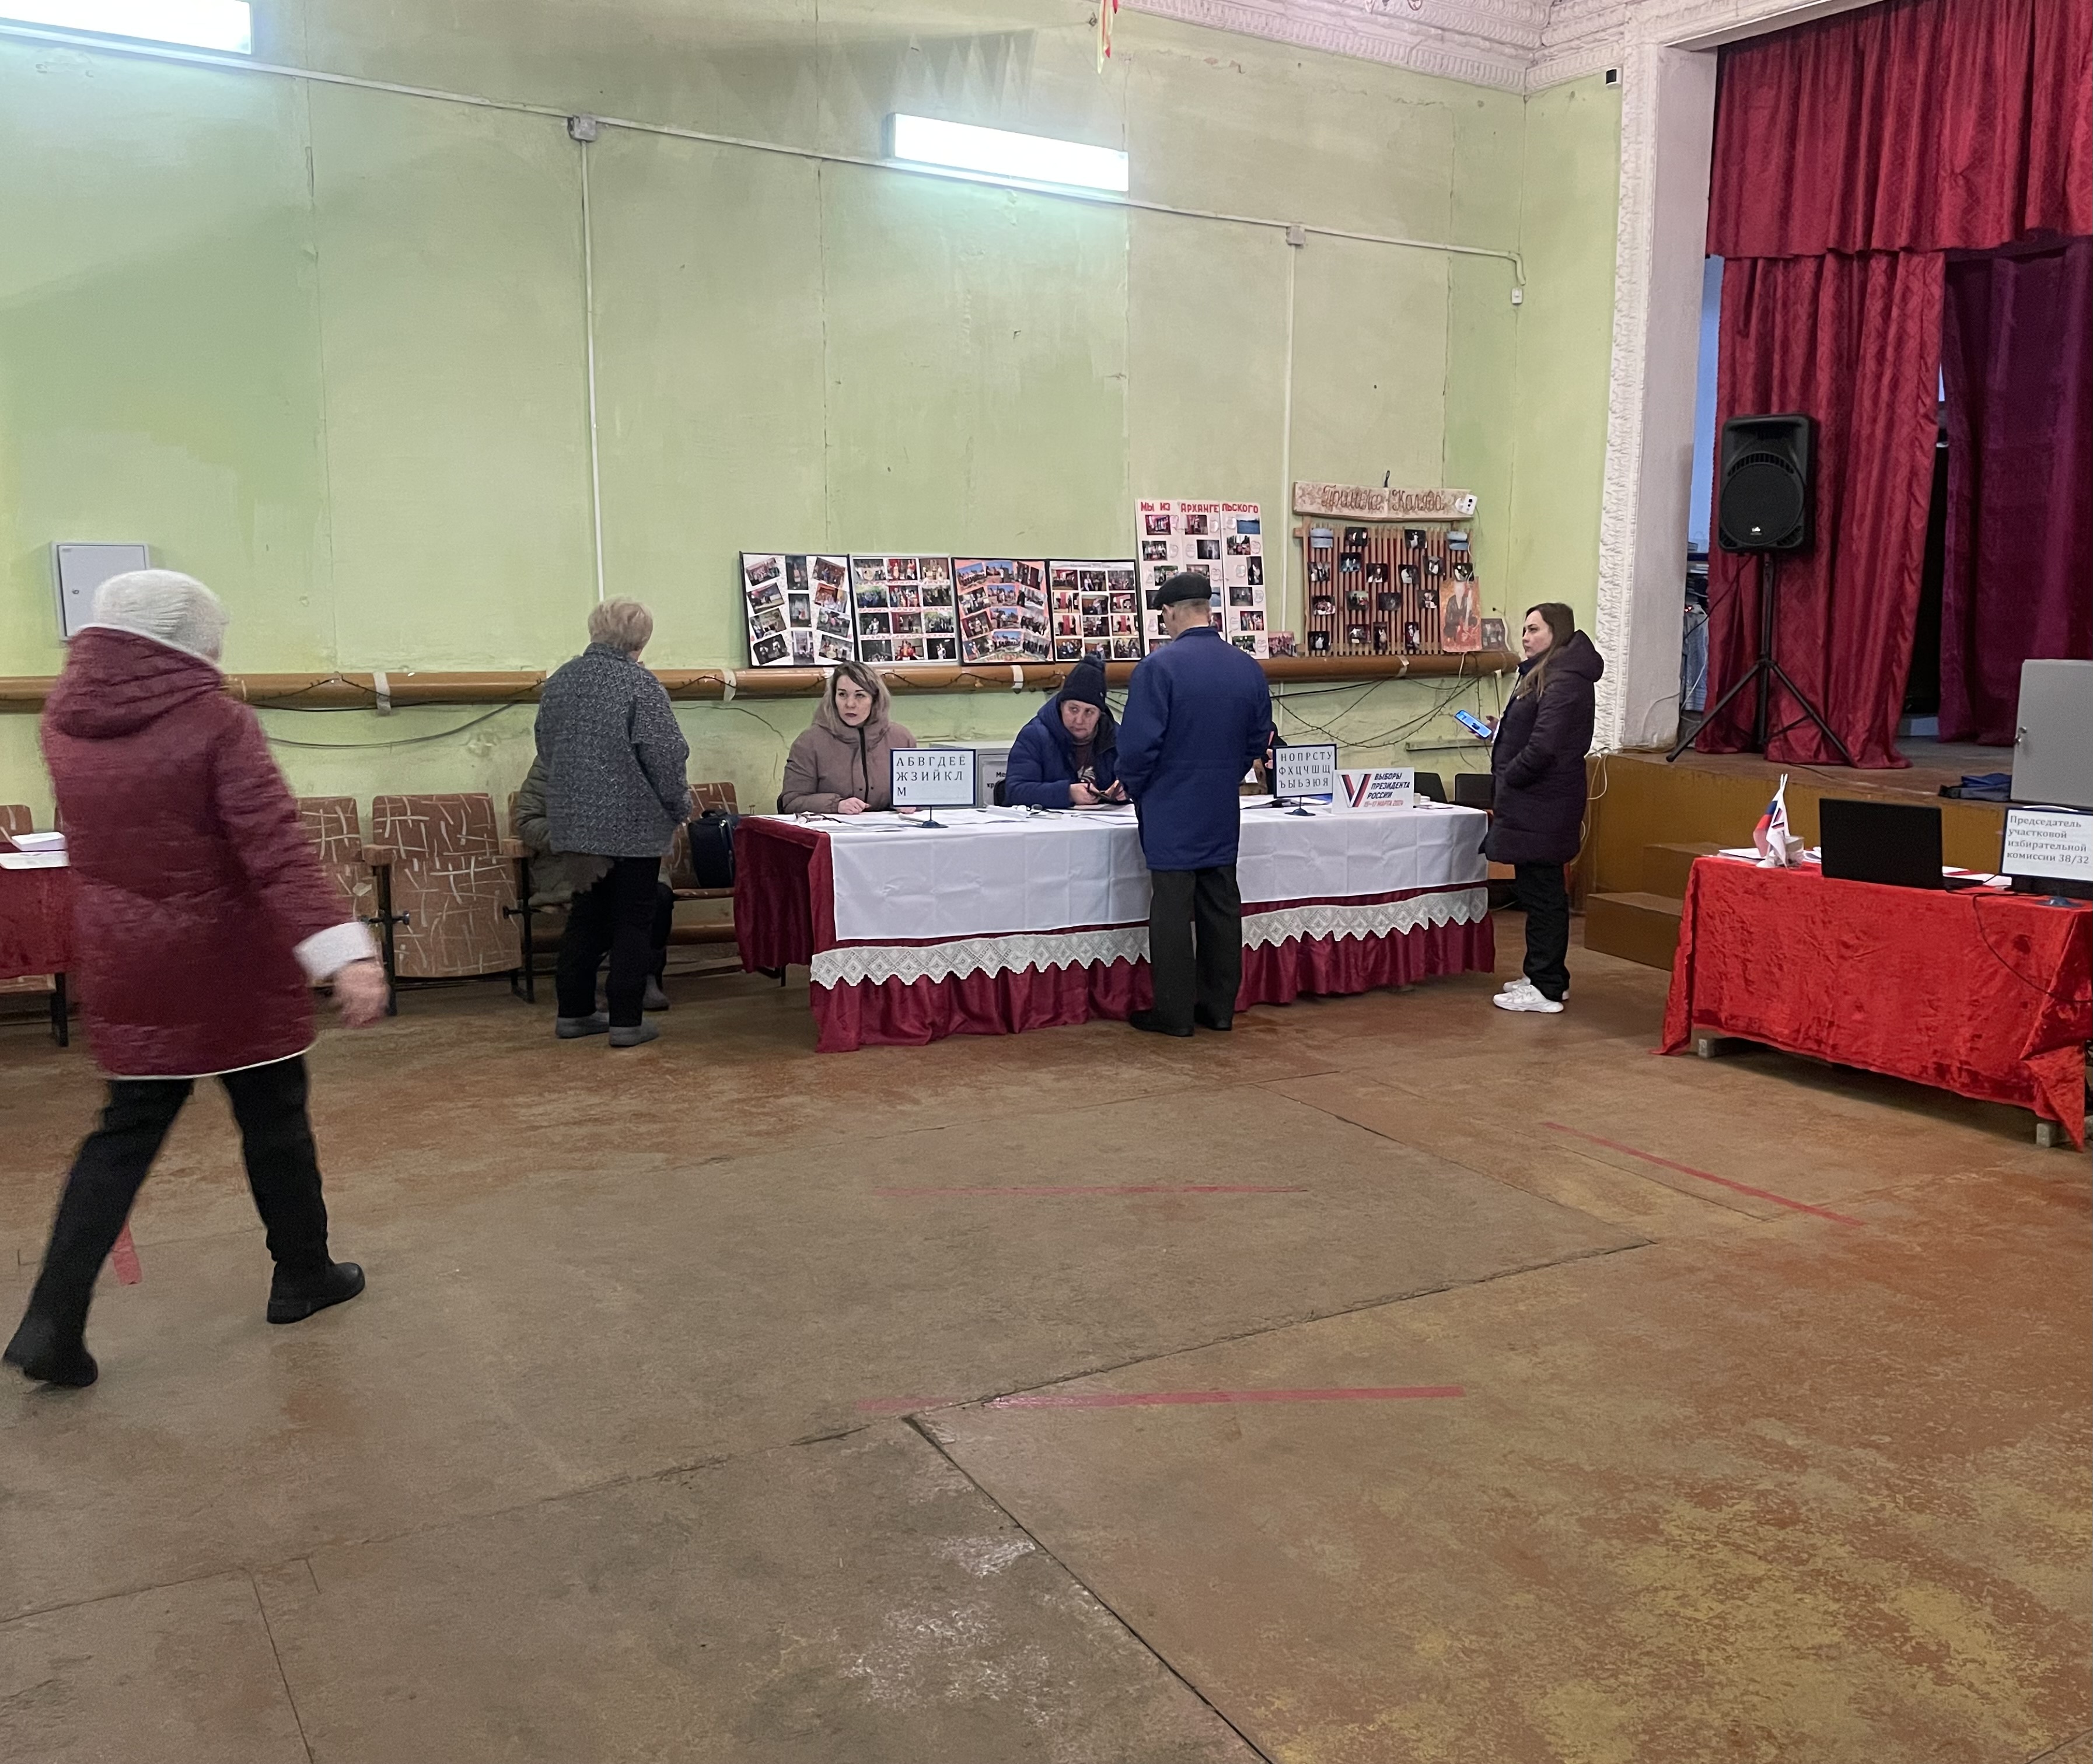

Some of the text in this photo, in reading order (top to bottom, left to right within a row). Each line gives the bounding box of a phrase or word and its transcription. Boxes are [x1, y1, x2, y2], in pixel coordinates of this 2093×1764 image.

[1141, 502, 1154, 512] МЫ
[1160, 502, 1170, 511] ИЗ
[1374, 772, 1403, 780] ВЫБОРЫ
[1371, 781, 1410, 790] ПРЕЗИДЕНТА
[897, 786, 906, 796] М
[1367, 791, 1393, 799] РОССИИ
[2010, 815, 2082, 828] Председатель
[2008, 828, 2067, 838] участковой
[2008, 840, 2087, 852] избирательной
[2007, 852, 2089, 864] комиссии 38/32
